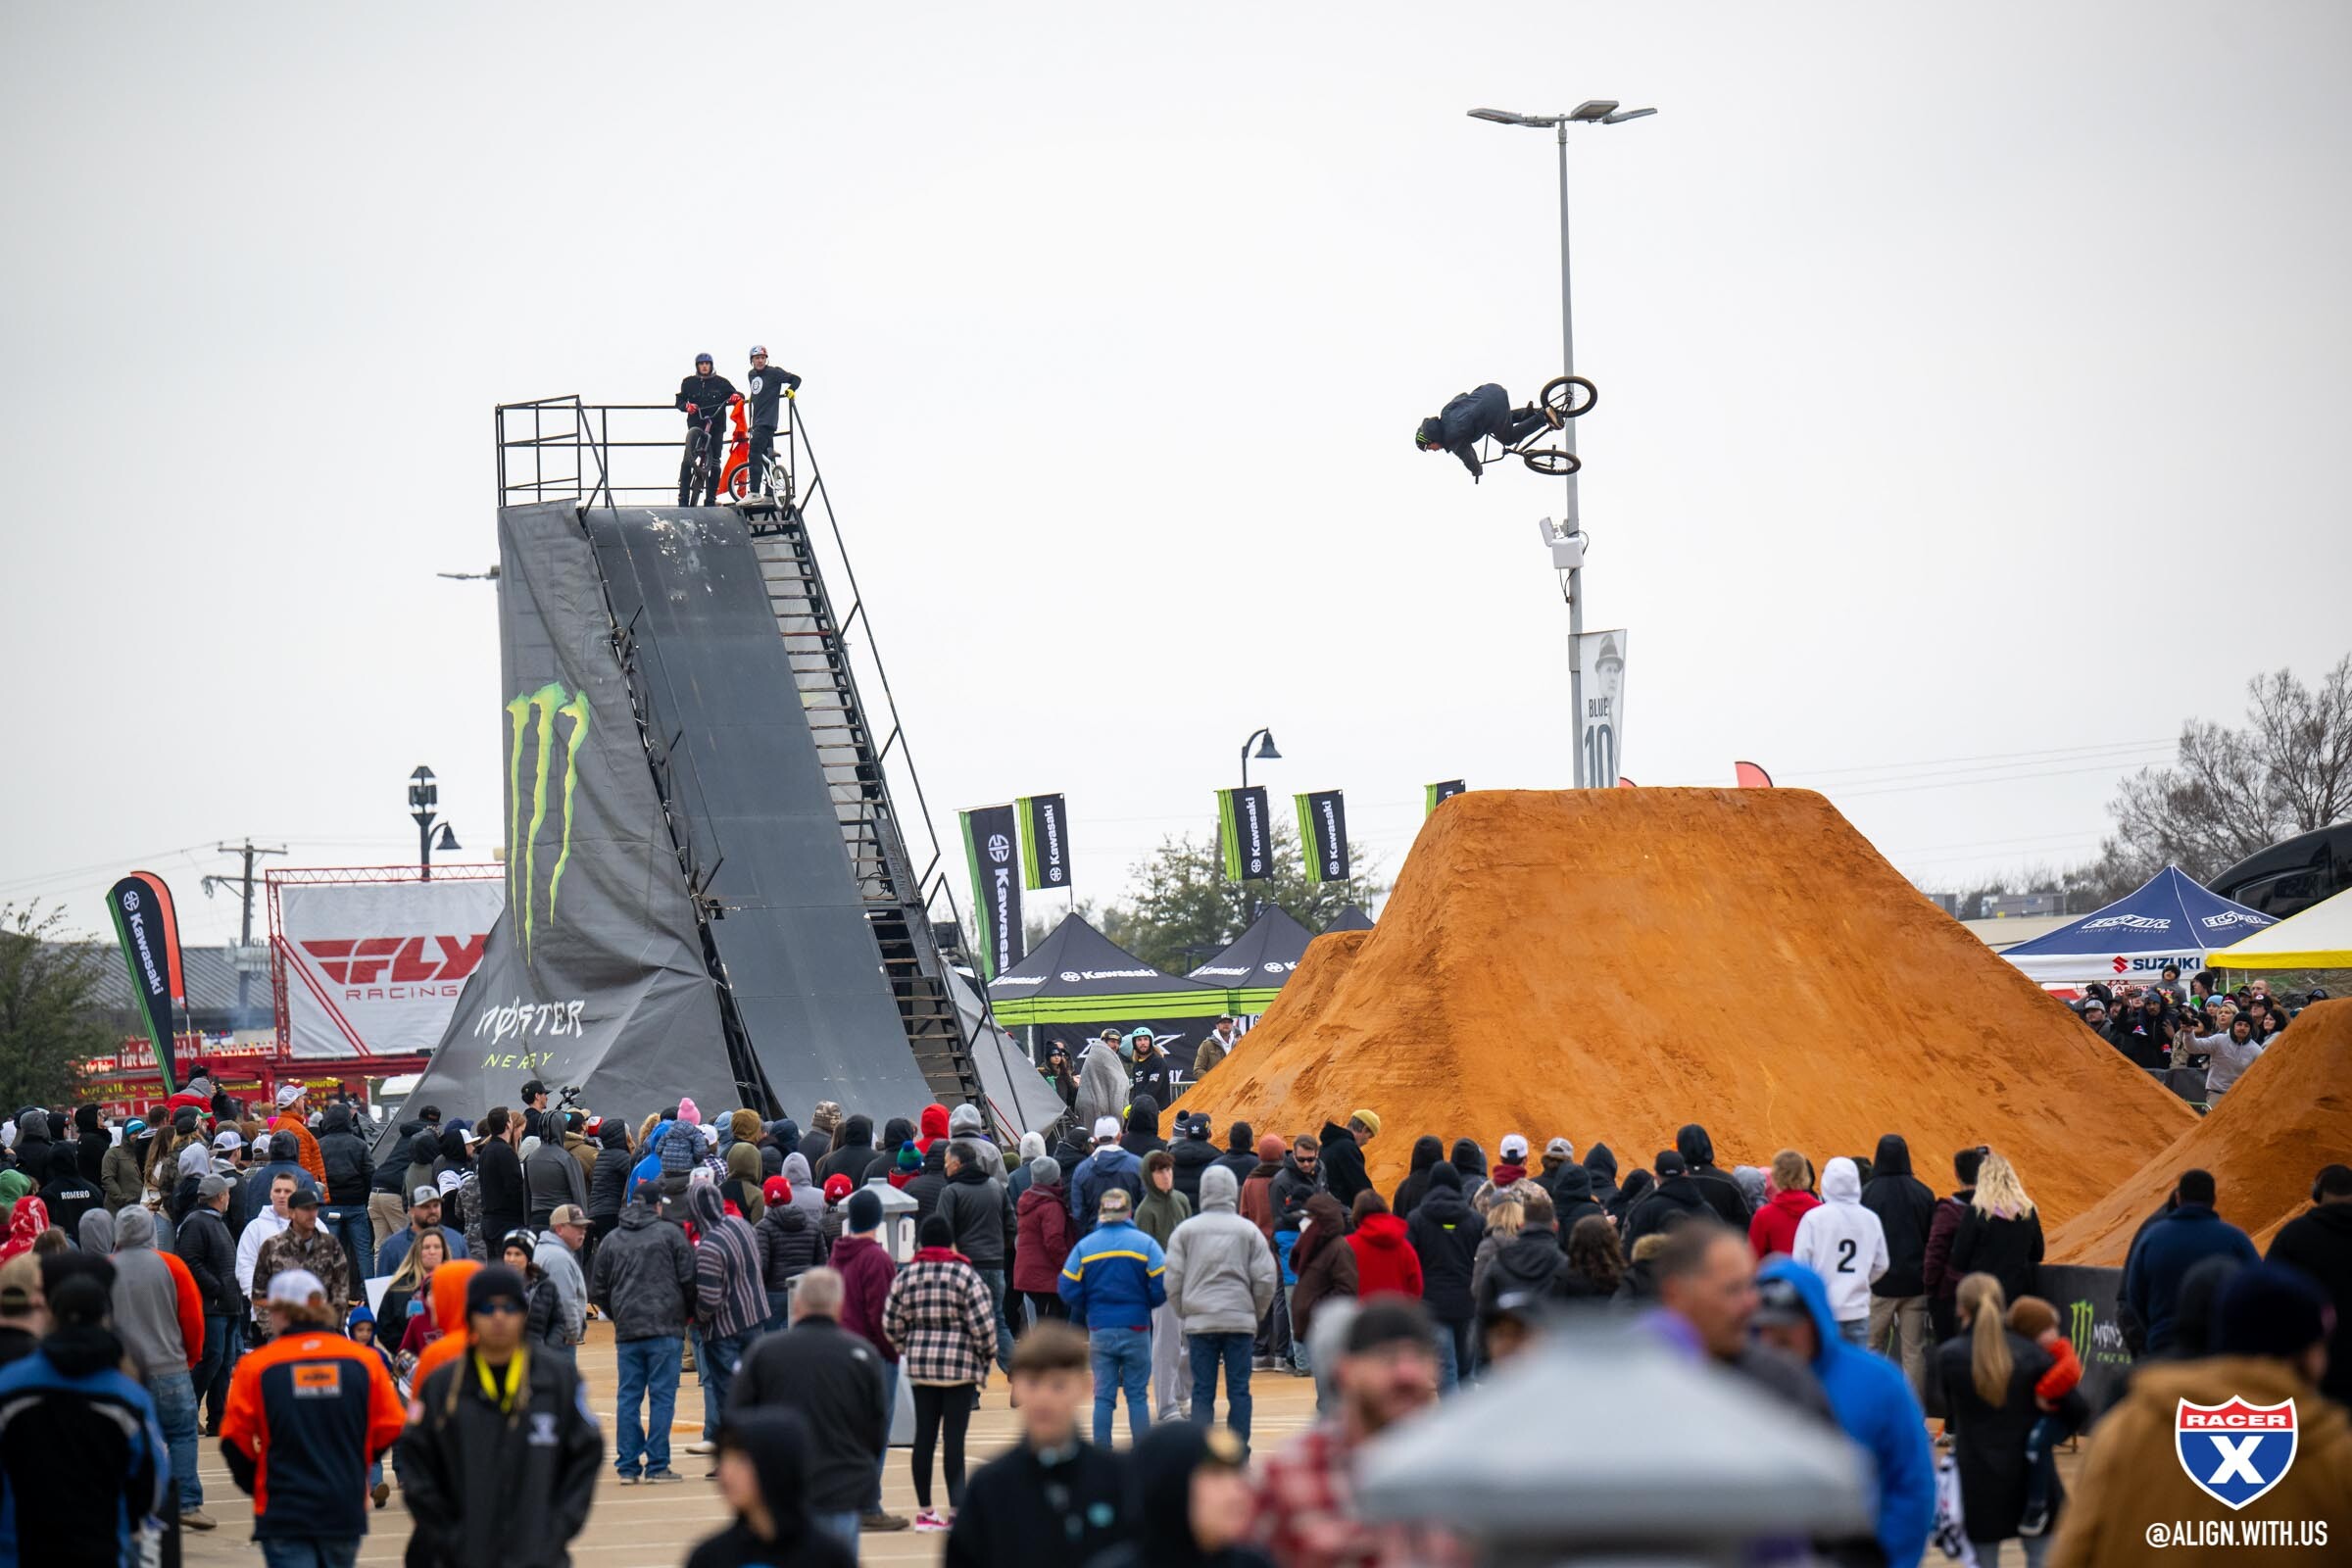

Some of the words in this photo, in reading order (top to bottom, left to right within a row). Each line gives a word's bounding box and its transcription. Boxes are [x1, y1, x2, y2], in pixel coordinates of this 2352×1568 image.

[1589, 697, 1608, 718] BLUE
[1584, 723, 1614, 789] 10
[1043, 804, 1060, 865] Kawasaki
[1245, 796, 1261, 858] Kawasaki
[1321, 800, 1339, 859] Kawasaki
[994, 867, 1010, 975] Kawasa
[129, 911, 164, 996] Kawasaki
[299, 933, 488, 986] FLY
[345, 985, 459, 1002] RACING
[60, 1190, 90, 1200] ROMERO
[1837, 1238, 1857, 1274] 2
